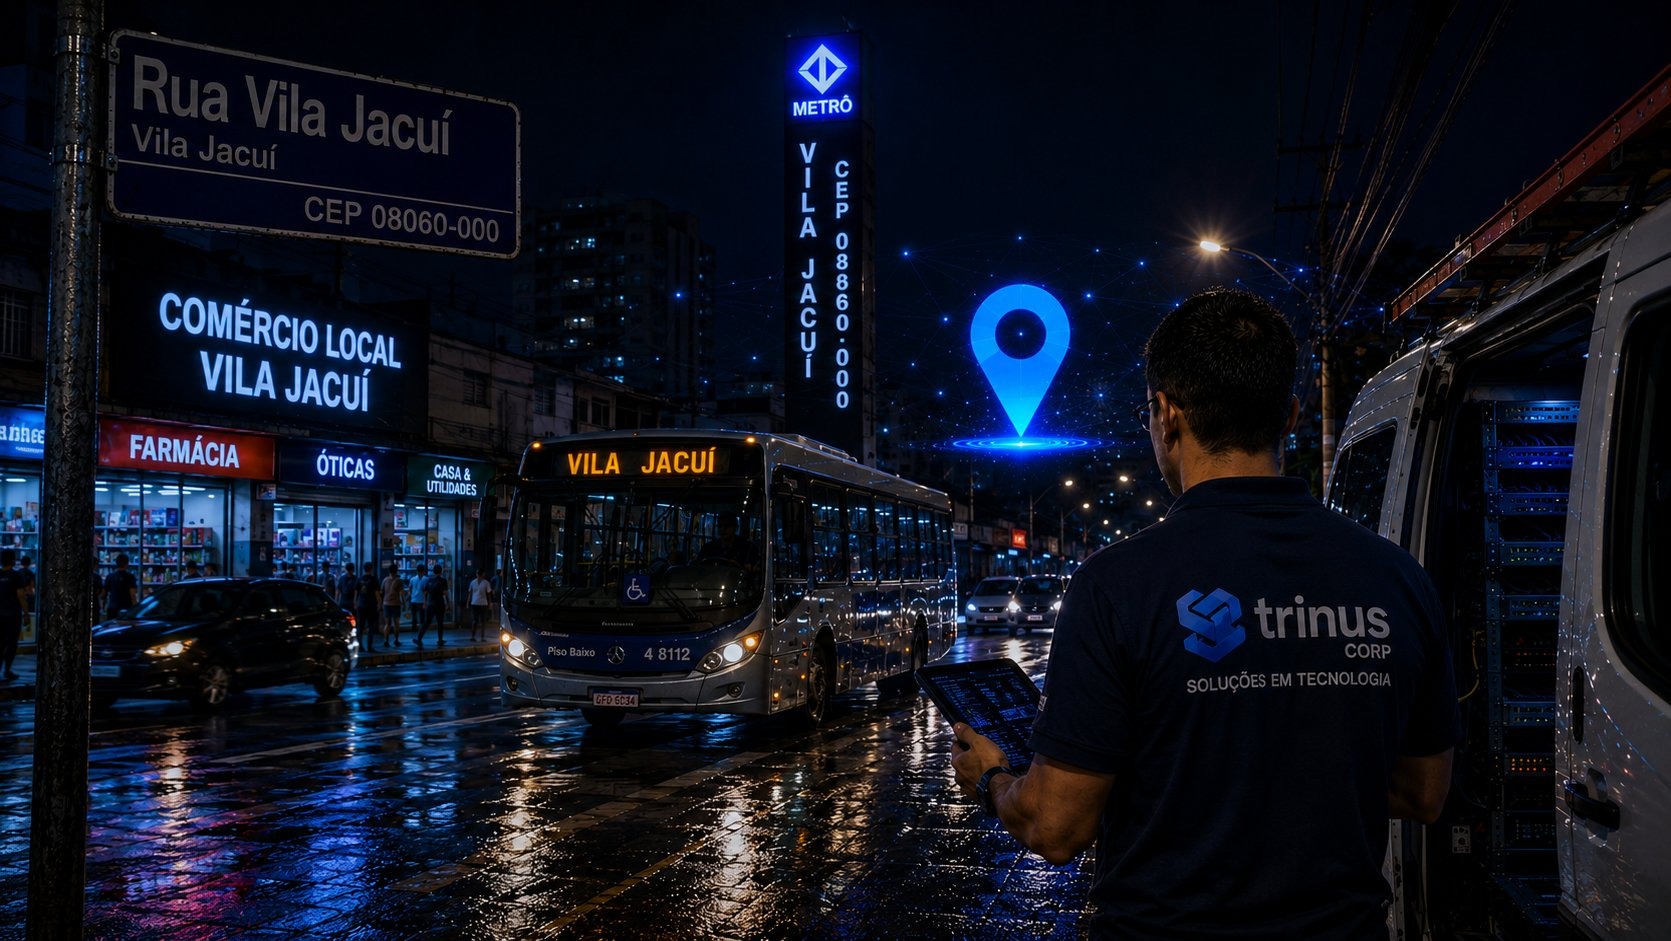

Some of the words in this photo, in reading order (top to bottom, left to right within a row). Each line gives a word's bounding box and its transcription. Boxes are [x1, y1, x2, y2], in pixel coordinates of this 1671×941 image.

[132, 54, 229, 124] Rua
[244, 74, 326, 138] Vila
[340, 94, 453, 156] Jacuí
[793, 94, 853, 117] METRÔ
[131, 123, 188, 158] Vila
[199, 135, 278, 170] Jacuí
[799, 143, 817, 238] VILA
[835, 160, 849, 219] CEP
[304, 196, 362, 225] CEP
[371, 204, 500, 243] 08060-000
[159, 293, 319, 354] COMÉRCIO
[326, 324, 401, 369] LOCAL
[799, 258, 818, 378] JACUÍ
[200, 350, 277, 399] VILA
[284, 368, 371, 412] JACUÍ
[130, 434, 240, 468] FARMÁCIA
[316, 448, 375, 480] ÓTICAS
[567, 452, 620, 475] VILA
[641, 447, 717, 474] JACUÍ
[427, 480, 477, 496] UTILIDADES
[433, 464, 462, 481] CASA
[463, 468, 471, 481] &
[1254, 595, 1391, 639] trinus
[547, 646, 567, 656] Piso
[570, 647, 596, 657] Baixo
[643, 648, 653, 661] 4
[658, 647, 691, 661] 8112
[1344, 643, 1391, 659] CORP
[1186, 671, 1266, 694] SOLUÇÕES
[1271, 673, 1292, 687] EM
[1297, 672, 1391, 687] TECNOLOGIA
